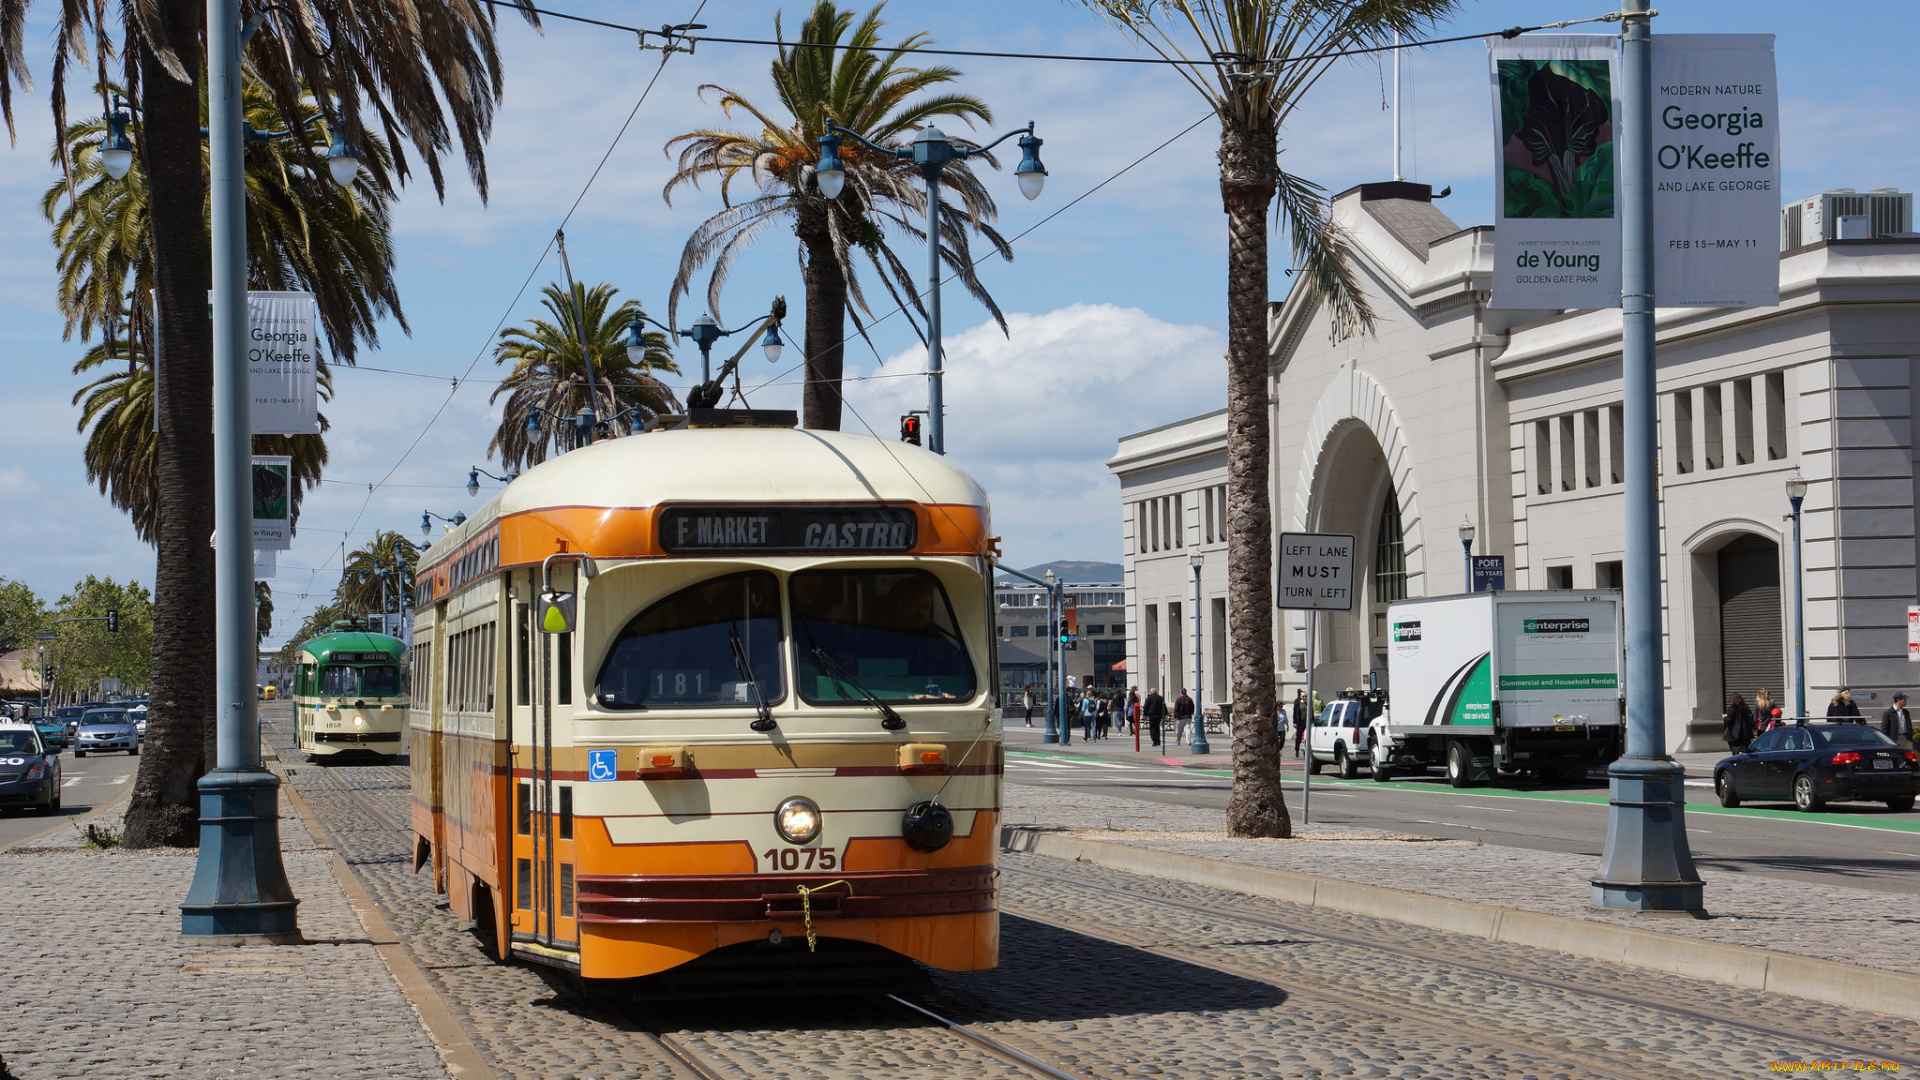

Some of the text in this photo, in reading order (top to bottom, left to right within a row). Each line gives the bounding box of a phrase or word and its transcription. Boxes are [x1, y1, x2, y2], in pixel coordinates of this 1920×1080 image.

[1660, 84, 1762, 96] MODERN NATURE
[1662, 105, 1763, 136] Georgia
[1657, 142, 1770, 170] O'Keeffe
[1657, 181, 1771, 192] AND LAKE GEORGE
[1669, 240, 1690, 249] FEB
[1745, 239, 1756, 248] 11
[1517, 250, 1600, 272] de Young
[1516, 275, 1598, 284] GOLDEN GATE PARK
[251, 327, 307, 346] Georgia
[249, 348, 311, 363] O'Keeffe
[260, 529, 282, 538] Young
[677, 517, 906, 548] F MARKET CASTRO
[1286, 545, 1348, 557] LEFT LANE
[1478, 559, 1499, 567] PORT
[1292, 565, 1340, 579] MUST
[1284, 587, 1347, 598] TURN LEFT
[1394, 624, 1421, 639] enterprise
[1524, 621, 1589, 631] enterprise
[763, 847, 836, 872] 1075
